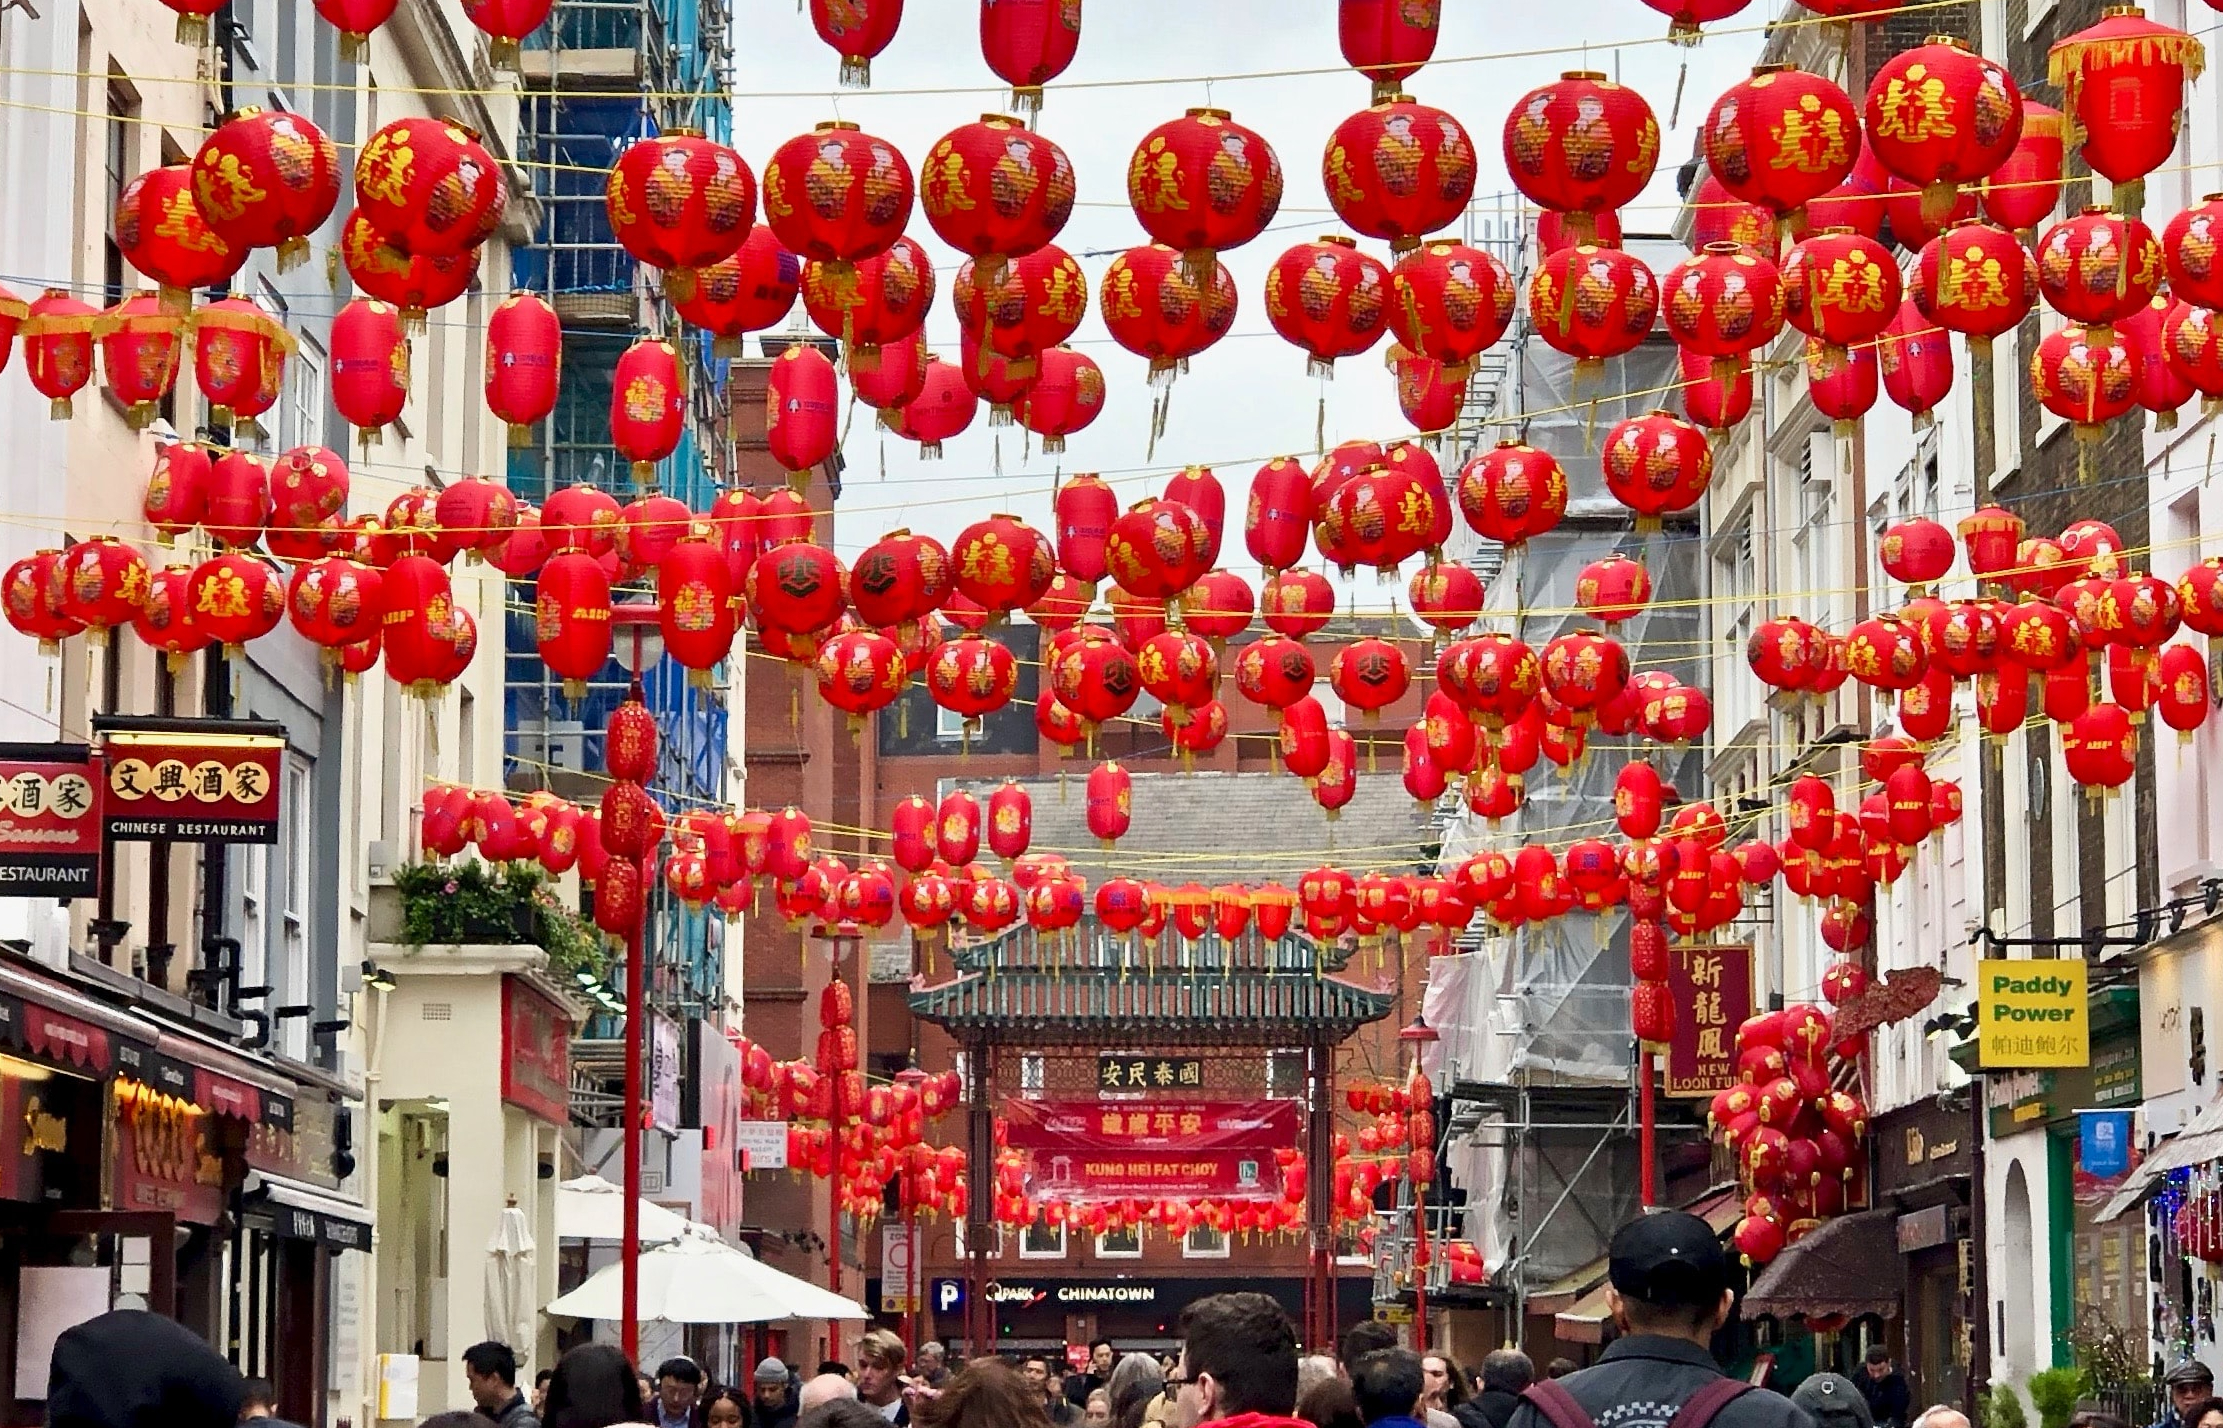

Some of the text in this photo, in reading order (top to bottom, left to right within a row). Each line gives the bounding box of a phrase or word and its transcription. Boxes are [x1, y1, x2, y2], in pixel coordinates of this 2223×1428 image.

[115, 764, 264, 798] 文興酒家
[0, 778, 87, 812] 酒家
[111, 821, 266, 837] CHINESE RESTAURANT
[0, 866, 90, 883] ESTAURANT
[1993, 976, 2073, 997] Paddy
[1691, 955, 1729, 1060] 新龍鳳
[1993, 1004, 2075, 1022] Power
[1992, 1035, 2079, 1057] 帕迪鲍尔
[1698, 1063, 1731, 1076] NEW
[1673, 1077, 1744, 1090] LOON FUN
[1085, 1163, 1218, 1176] KUNG HEI FAT CHOY
[1058, 1287, 1155, 1301] CHINATOWN
